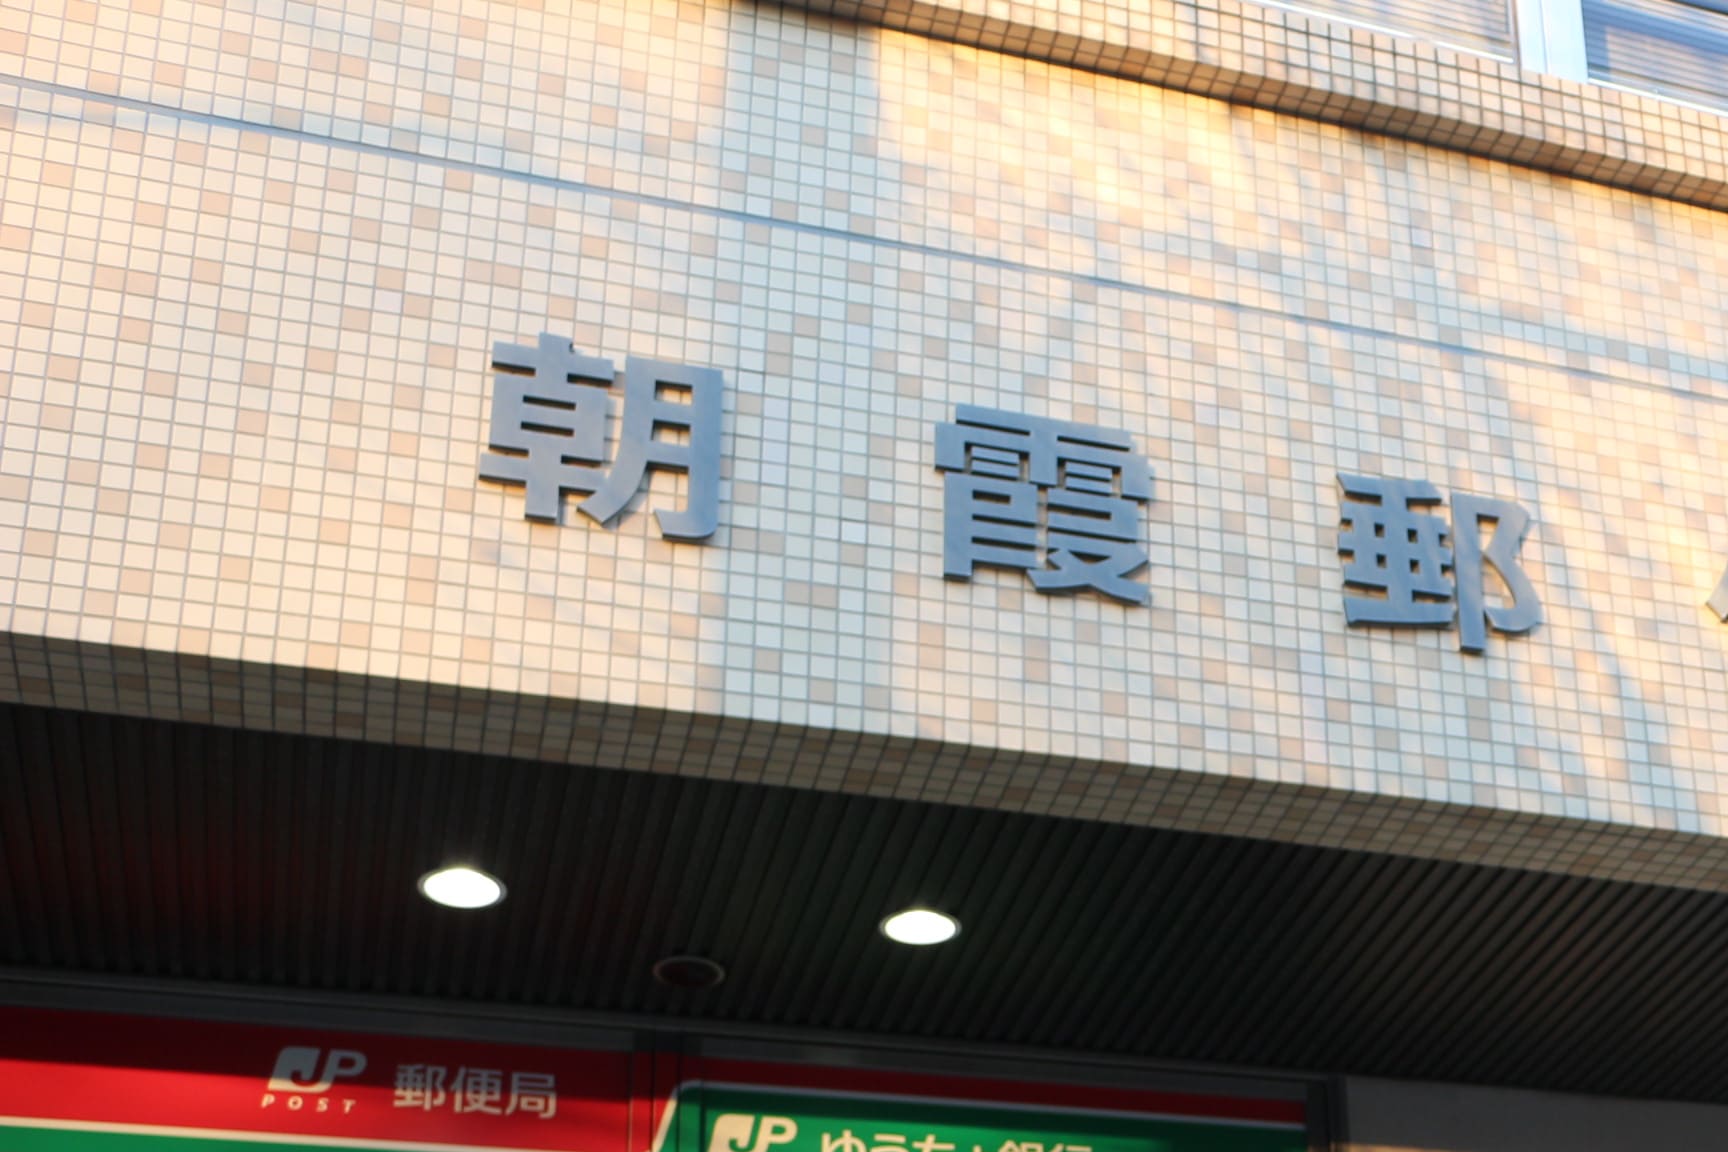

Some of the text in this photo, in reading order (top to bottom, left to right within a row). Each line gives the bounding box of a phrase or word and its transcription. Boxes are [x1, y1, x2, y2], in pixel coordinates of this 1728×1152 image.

[261, 1094, 356, 1113] POST
[393, 1064, 556, 1118] 郵便局
